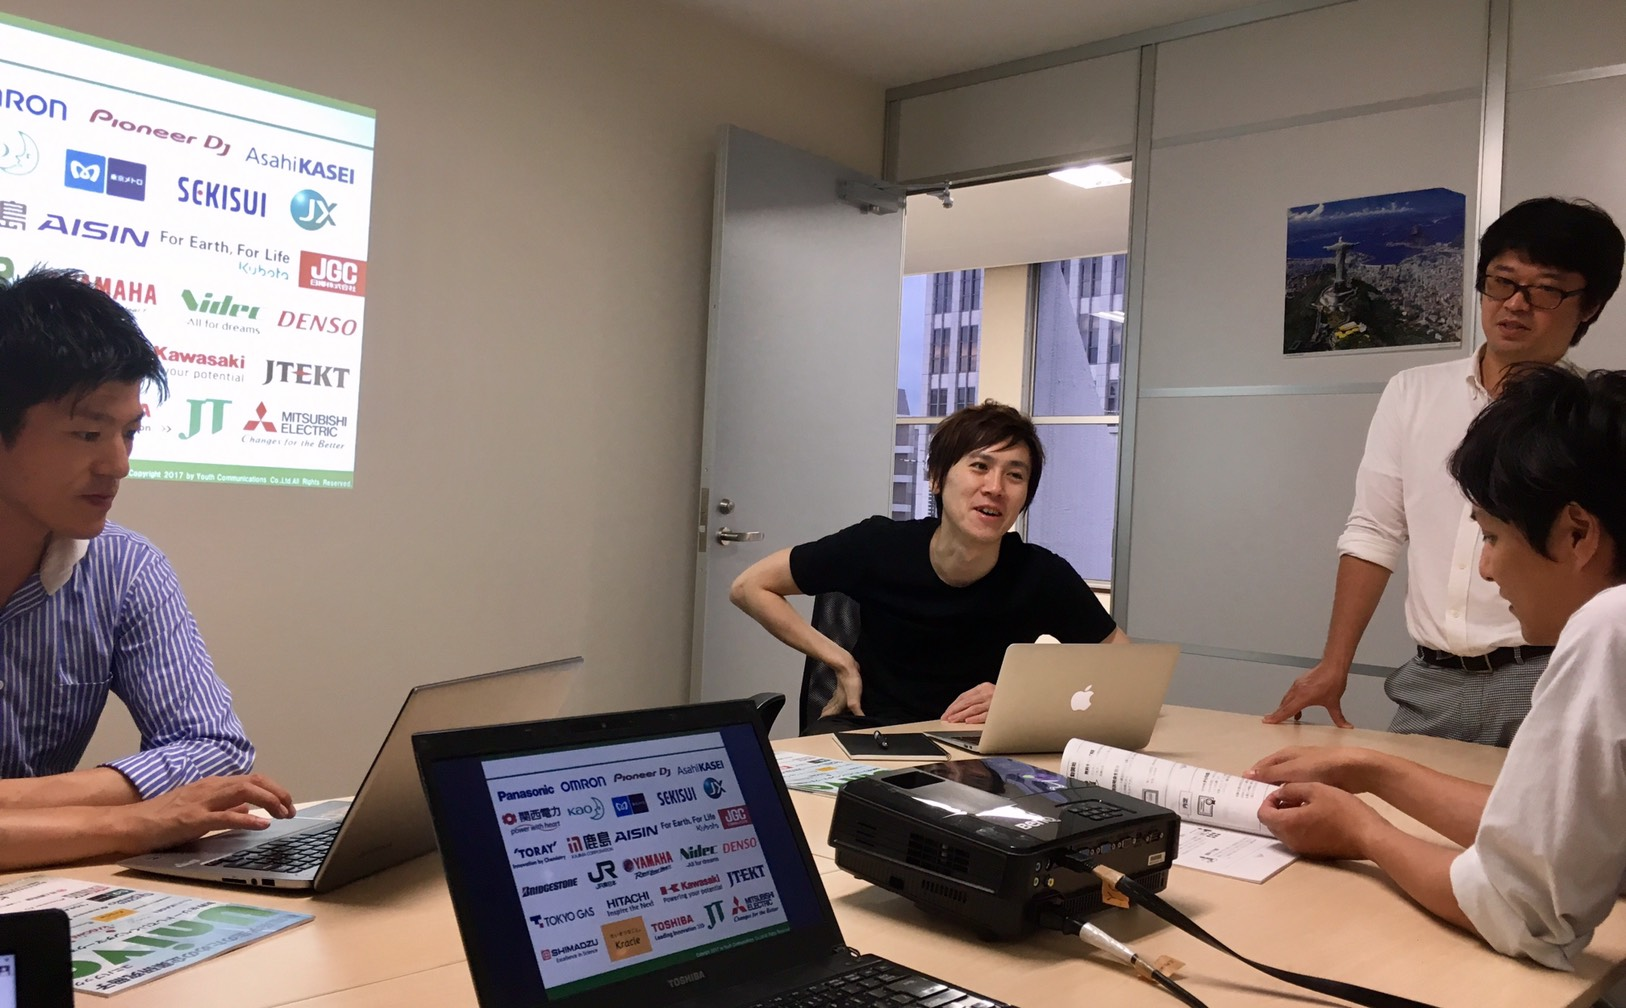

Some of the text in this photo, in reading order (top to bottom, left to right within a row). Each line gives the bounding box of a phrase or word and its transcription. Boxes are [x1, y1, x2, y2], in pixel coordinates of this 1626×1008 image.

[0, 89, 67, 121] RON
[89, 109, 197, 144] Pioneer
[178, 176, 266, 217] SEKISUI
[298, 198, 338, 226] JX
[37, 214, 149, 247] AISIN
[160, 230, 290, 264] For Earth, For Life
[238, 261, 289, 280] Kubota
[311, 257, 358, 285] JGC
[82, 273, 157, 305] MAHA
[181, 289, 260, 320] Nidec
[205, 319, 219, 330] for
[221, 322, 261, 335] dreams
[277, 310, 357, 336] DENSO
[154, 345, 245, 369] Kawasaki
[194, 370, 244, 382] potential
[262, 359, 350, 388] JTEKT
[178, 398, 232, 440] JT
[281, 411, 347, 427] MITSUBISHI
[281, 423, 338, 438] ELECTRIC
[241, 434, 345, 450] Changes for the Better
[164, 471, 183, 480] 2017
[196, 472, 215, 482] Youth
[216, 473, 267, 484] Communications
[302, 476, 320, 487] Rights
[560, 776, 607, 792] OMRON
[614, 770, 657, 782] Pioneer
[497, 785, 555, 802] Panasonic
[657, 787, 697, 806] SEKISUI
[660, 821, 671, 830] For
[692, 815, 703, 823] For
[703, 813, 716, 821] Life
[725, 808, 747, 823] JGC
[544, 821, 561, 829] heart
[615, 825, 658, 843] AISIN
[680, 845, 718, 860] Nidec
[723, 837, 757, 853] DENSO
[512, 859, 537, 869] Innovation
[633, 851, 674, 870] YAMAHA
[587, 860, 618, 883] JR
[727, 865, 766, 888] JTEKT
[522, 877, 578, 897] BRIDGESTONE
[680, 874, 720, 890] Kawasaki
[606, 891, 650, 909] HITACHI
[663, 884, 723, 903] Powering your potential
[744, 891, 775, 904] MITSUBISHI
[607, 907, 629, 917] Inspire
[640, 900, 654, 908] Next
[747, 899, 774, 911] ELECTRIC
[544, 907, 595, 927] TOKYO GAS
[651, 915, 694, 933] TOSHIBA
[703, 900, 725, 930] JT
[654, 926, 697, 941] Leading Innovation
[551, 939, 599, 957] SHIMADZU
[615, 936, 641, 950] Kracie
[667, 970, 706, 988] TOSHIBA
